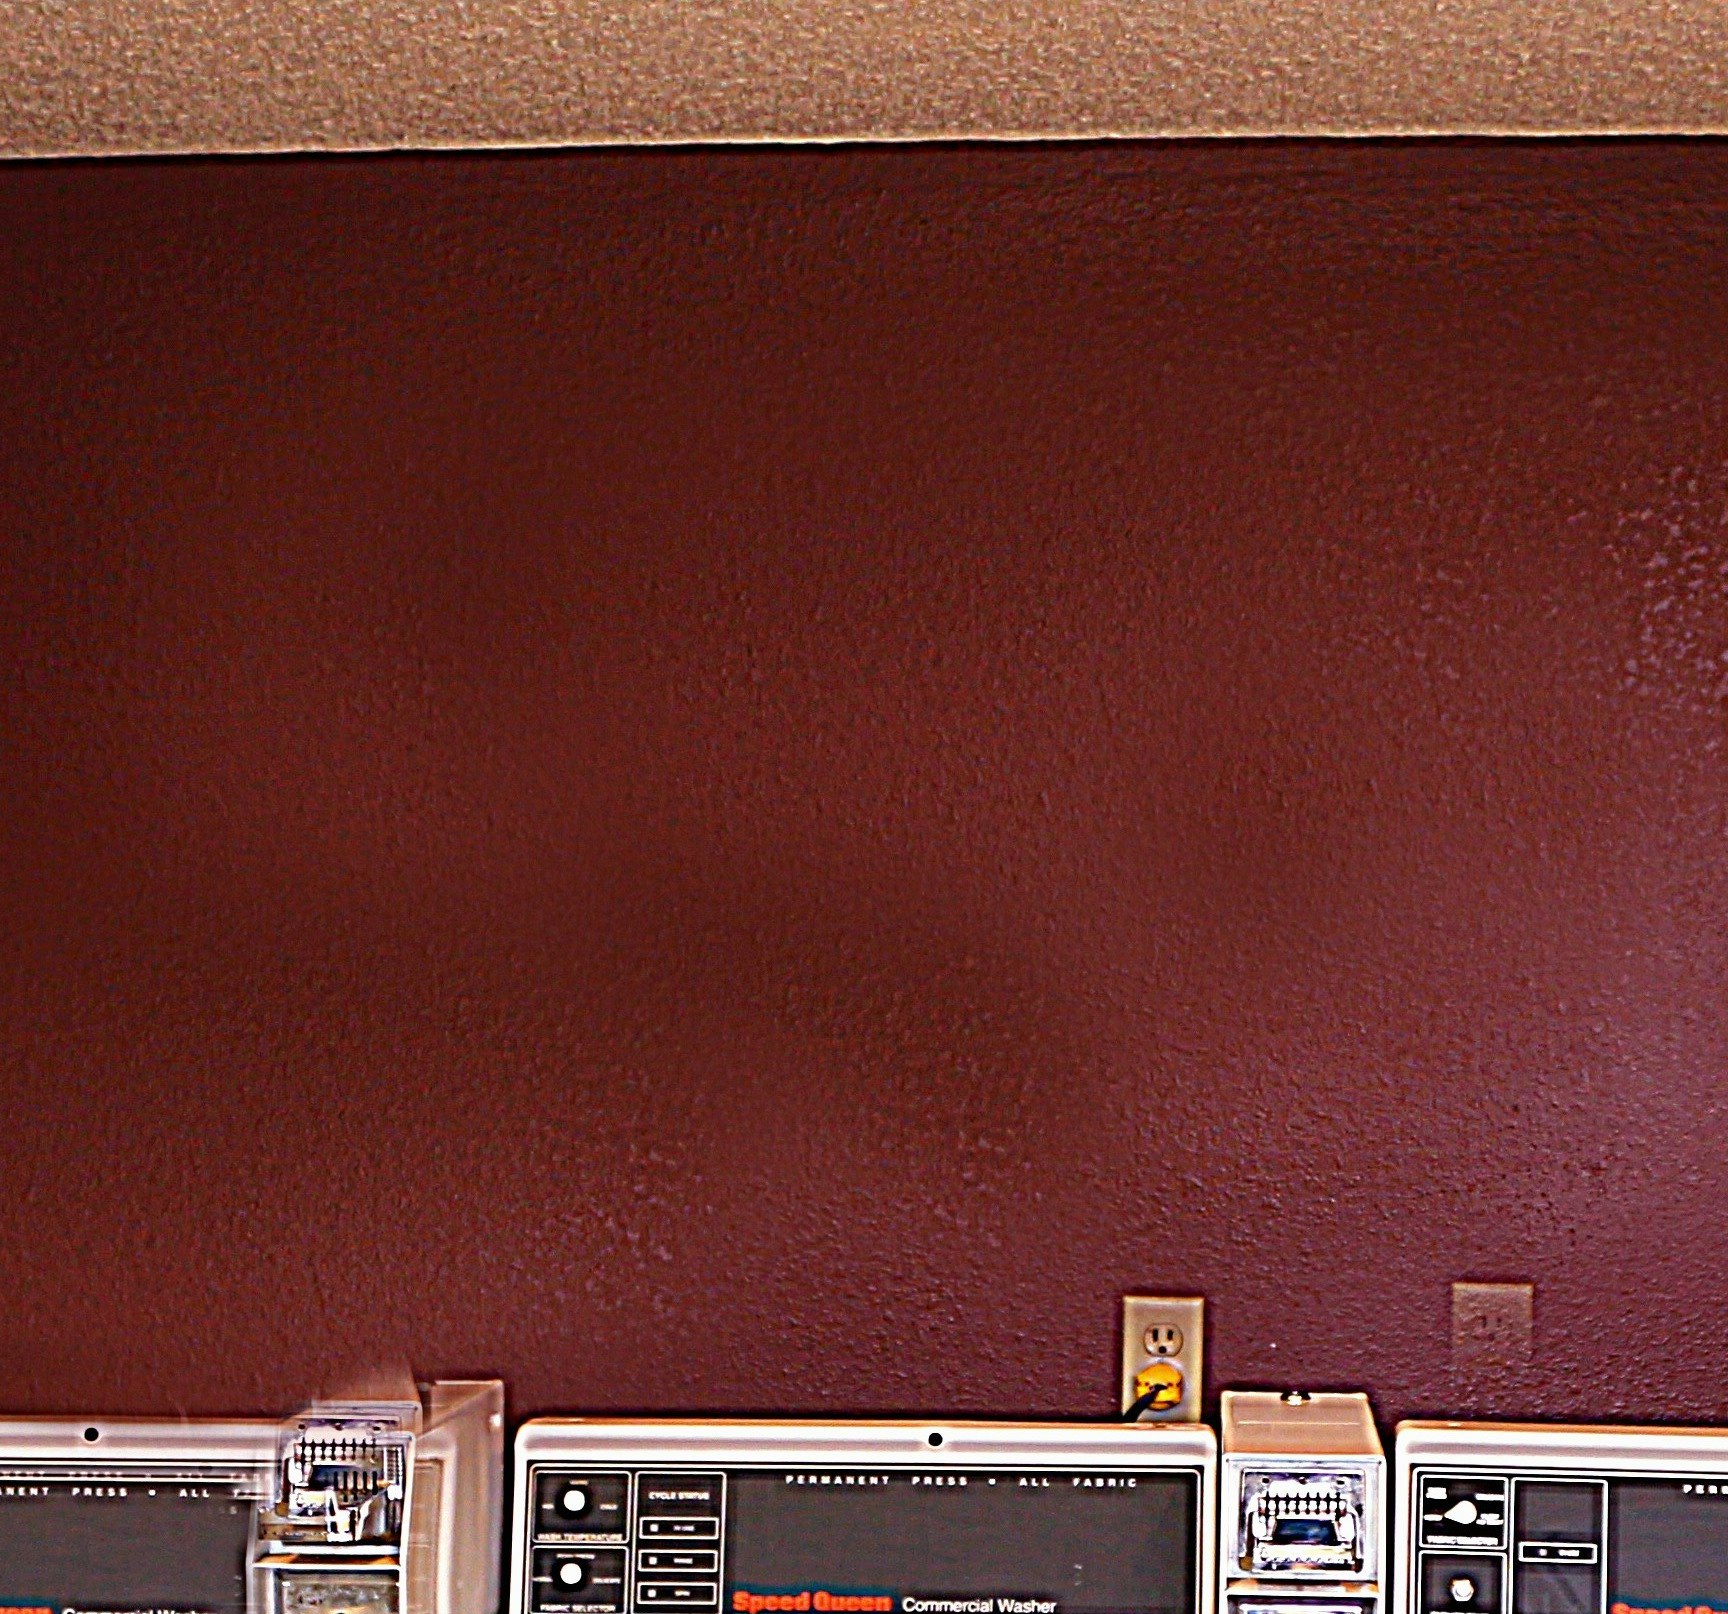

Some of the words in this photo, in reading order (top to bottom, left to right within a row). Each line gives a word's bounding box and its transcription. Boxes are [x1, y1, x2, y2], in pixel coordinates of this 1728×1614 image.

[785, 1474, 889, 1485] PERMANENT
[911, 1475, 968, 1487] PRESS
[1019, 1477, 1050, 1487] ALL
[1072, 1477, 1137, 1488] FABRIC
[72, 1486, 128, 1498] PRESS
[179, 1487, 210, 1498] ALL
[732, 1590, 811, 1614] Speed
[812, 1590, 893, 1612] Queen
[902, 1597, 994, 1613] Commercial
[997, 1598, 1058, 1614] Washer
